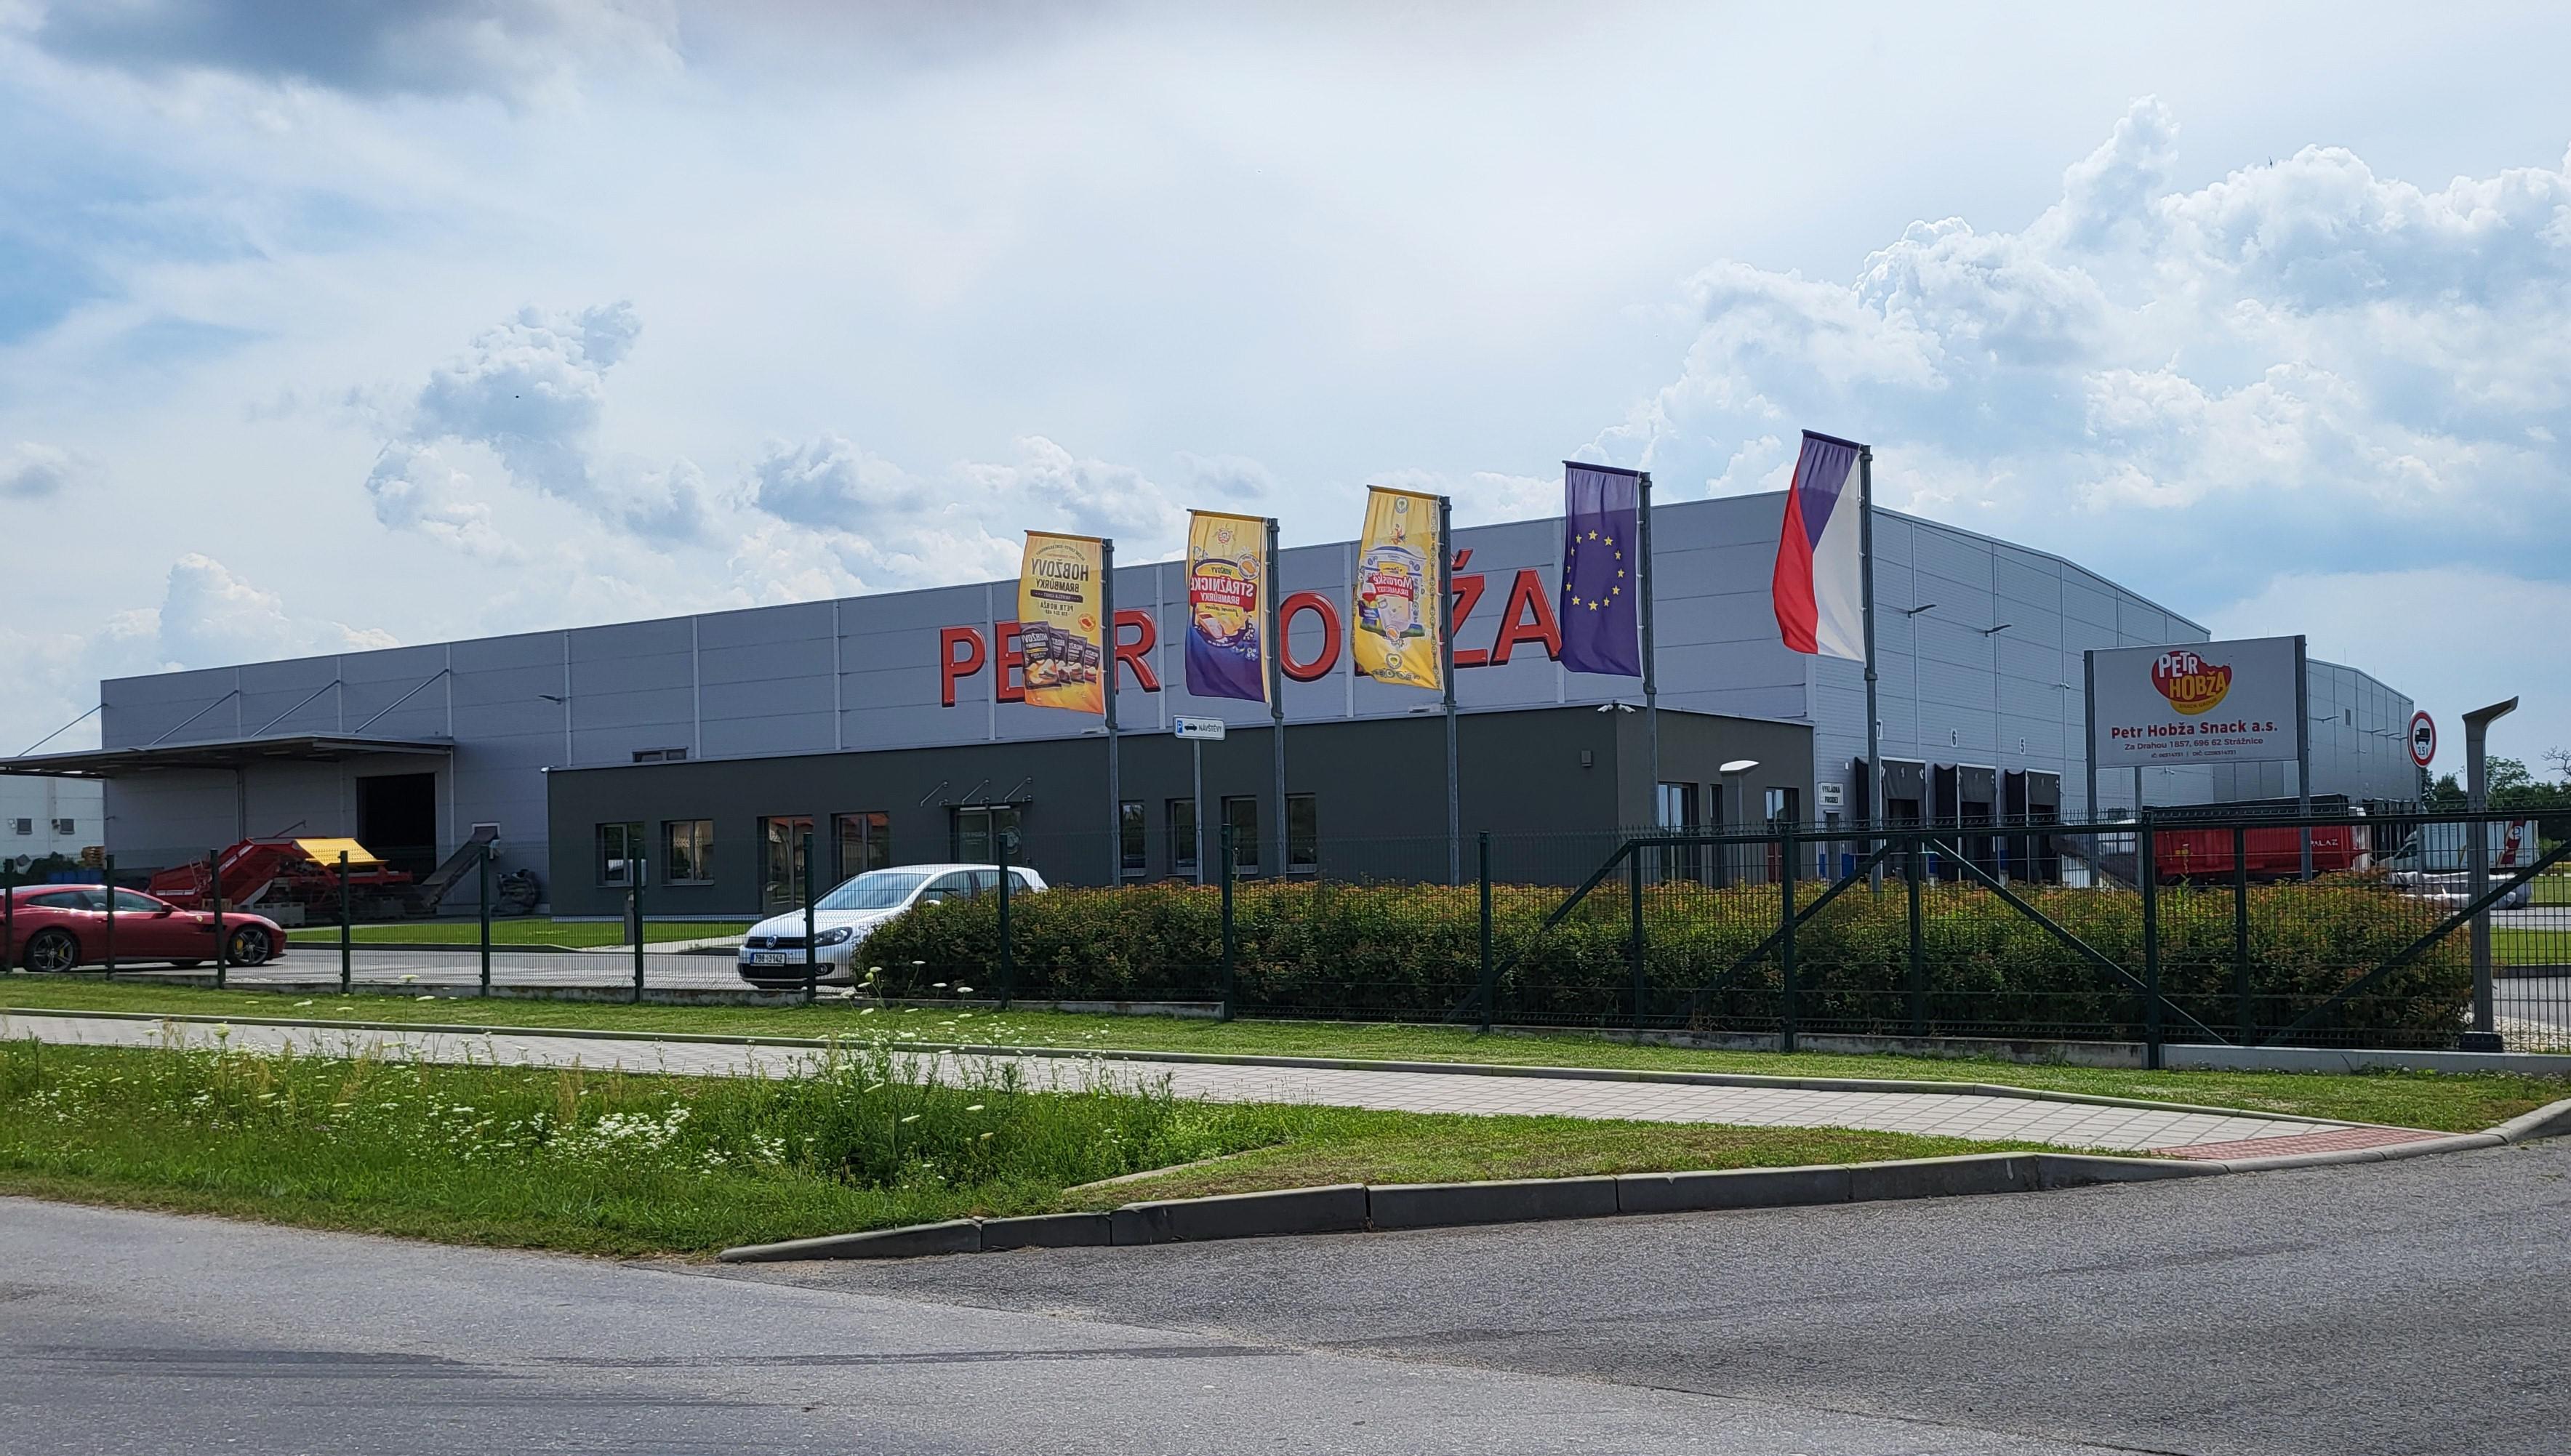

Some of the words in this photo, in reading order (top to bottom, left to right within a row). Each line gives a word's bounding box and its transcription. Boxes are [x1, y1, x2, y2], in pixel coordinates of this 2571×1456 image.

[941, 609, 1161, 707] PER
[1280, 549, 1562, 683] OŽA
[2158, 652, 2198, 677] PETR
[2169, 670, 2226, 700] HOBŽA
[1952, 730, 1957, 746] 6
[2111, 726, 2143, 739] Petr
[2147, 722, 2195, 737] Hobža
[2199, 720, 2247, 734] Snack
[2252, 721, 2278, 733] a.s.
[2021, 739, 2025, 754] 5
